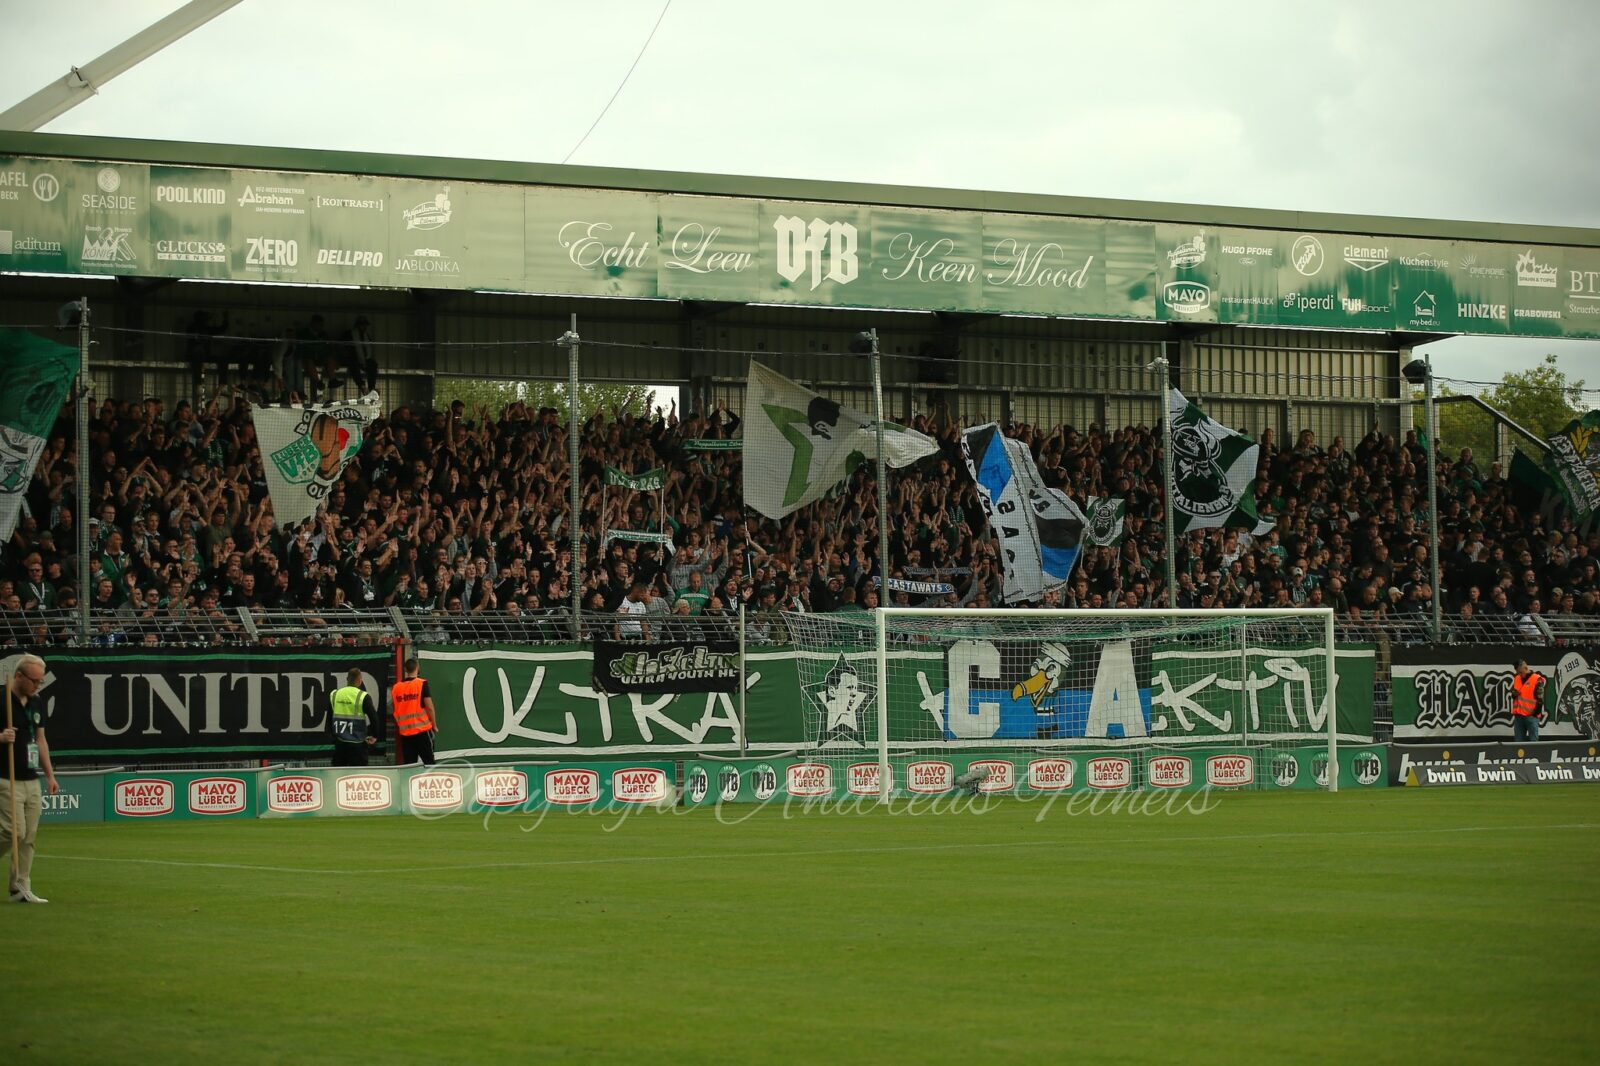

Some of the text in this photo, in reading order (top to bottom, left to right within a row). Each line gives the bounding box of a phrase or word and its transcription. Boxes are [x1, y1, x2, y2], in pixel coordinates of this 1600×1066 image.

[82, 194, 136, 210] SEASIDE
[238, 185, 294, 207] Abraham
[14, 237, 61, 251] aditum
[558, 220, 651, 271] Echt
[773, 214, 859, 292] VfB
[881, 232, 981, 283] Keen
[987, 238, 1094, 289] Mood
[1222, 245, 1273, 256] HUGO PFOHE
[1343, 245, 1388, 259] clement
[317, 249, 383, 267] DELLPRO
[1399, 256, 1449, 269] Küchenstyle
[395, 259, 461, 273] JABLONKA
[1168, 288, 1206, 302] MAYO
[1297, 293, 1334, 312] iperdi
[1457, 303, 1506, 319] HINZKE
[1513, 309, 1561, 318] GRABOWSKI
[1563, 658, 1580, 673] 1919
[333, 720, 354, 735] 171
[1035, 763, 1066, 773] MAYO
[1093, 762, 1124, 772] MAYO
[1155, 761, 1184, 771] MAYO
[1213, 760, 1246, 769] MAYO
[1312, 760, 1329, 779] Vf
[793, 768, 825, 779] MAYO
[914, 766, 946, 776] MAYO
[1094, 772, 1123, 781] LÜBECK
[1155, 771, 1184, 779] LÜBECK
[1214, 769, 1245, 778] LÜBECK
[1427, 767, 1466, 783] bwin
[1477, 766, 1516, 782] bwin
[1535, 765, 1573, 781] bwin
[484, 775, 520, 787] MAYO
[553, 774, 590, 786] MAYO
[621, 773, 658, 785] MAYO
[794, 778, 825, 787] LÜBECK
[854, 778, 880, 787] LÜBEC
[914, 777, 946, 785] LÜBECK
[1035, 773, 1065, 782] LÜBECK
[198, 783, 237, 795] MAYO
[276, 781, 313, 793] MAYO
[345, 780, 382, 792] MAYO
[418, 778, 454, 790] MAYO
[553, 784, 590, 795] LÜBECK
[621, 783, 657, 793] LÜBECK
[124, 784, 164, 797] MAYO
[345, 790, 382, 801] LÜBECK
[418, 789, 454, 800] LÜBECK
[484, 786, 520, 797] LÜBECK
[125, 795, 164, 807] LÜBECK
[198, 794, 236, 805] LÜBECK
[276, 793, 313, 803] LÜBECK
